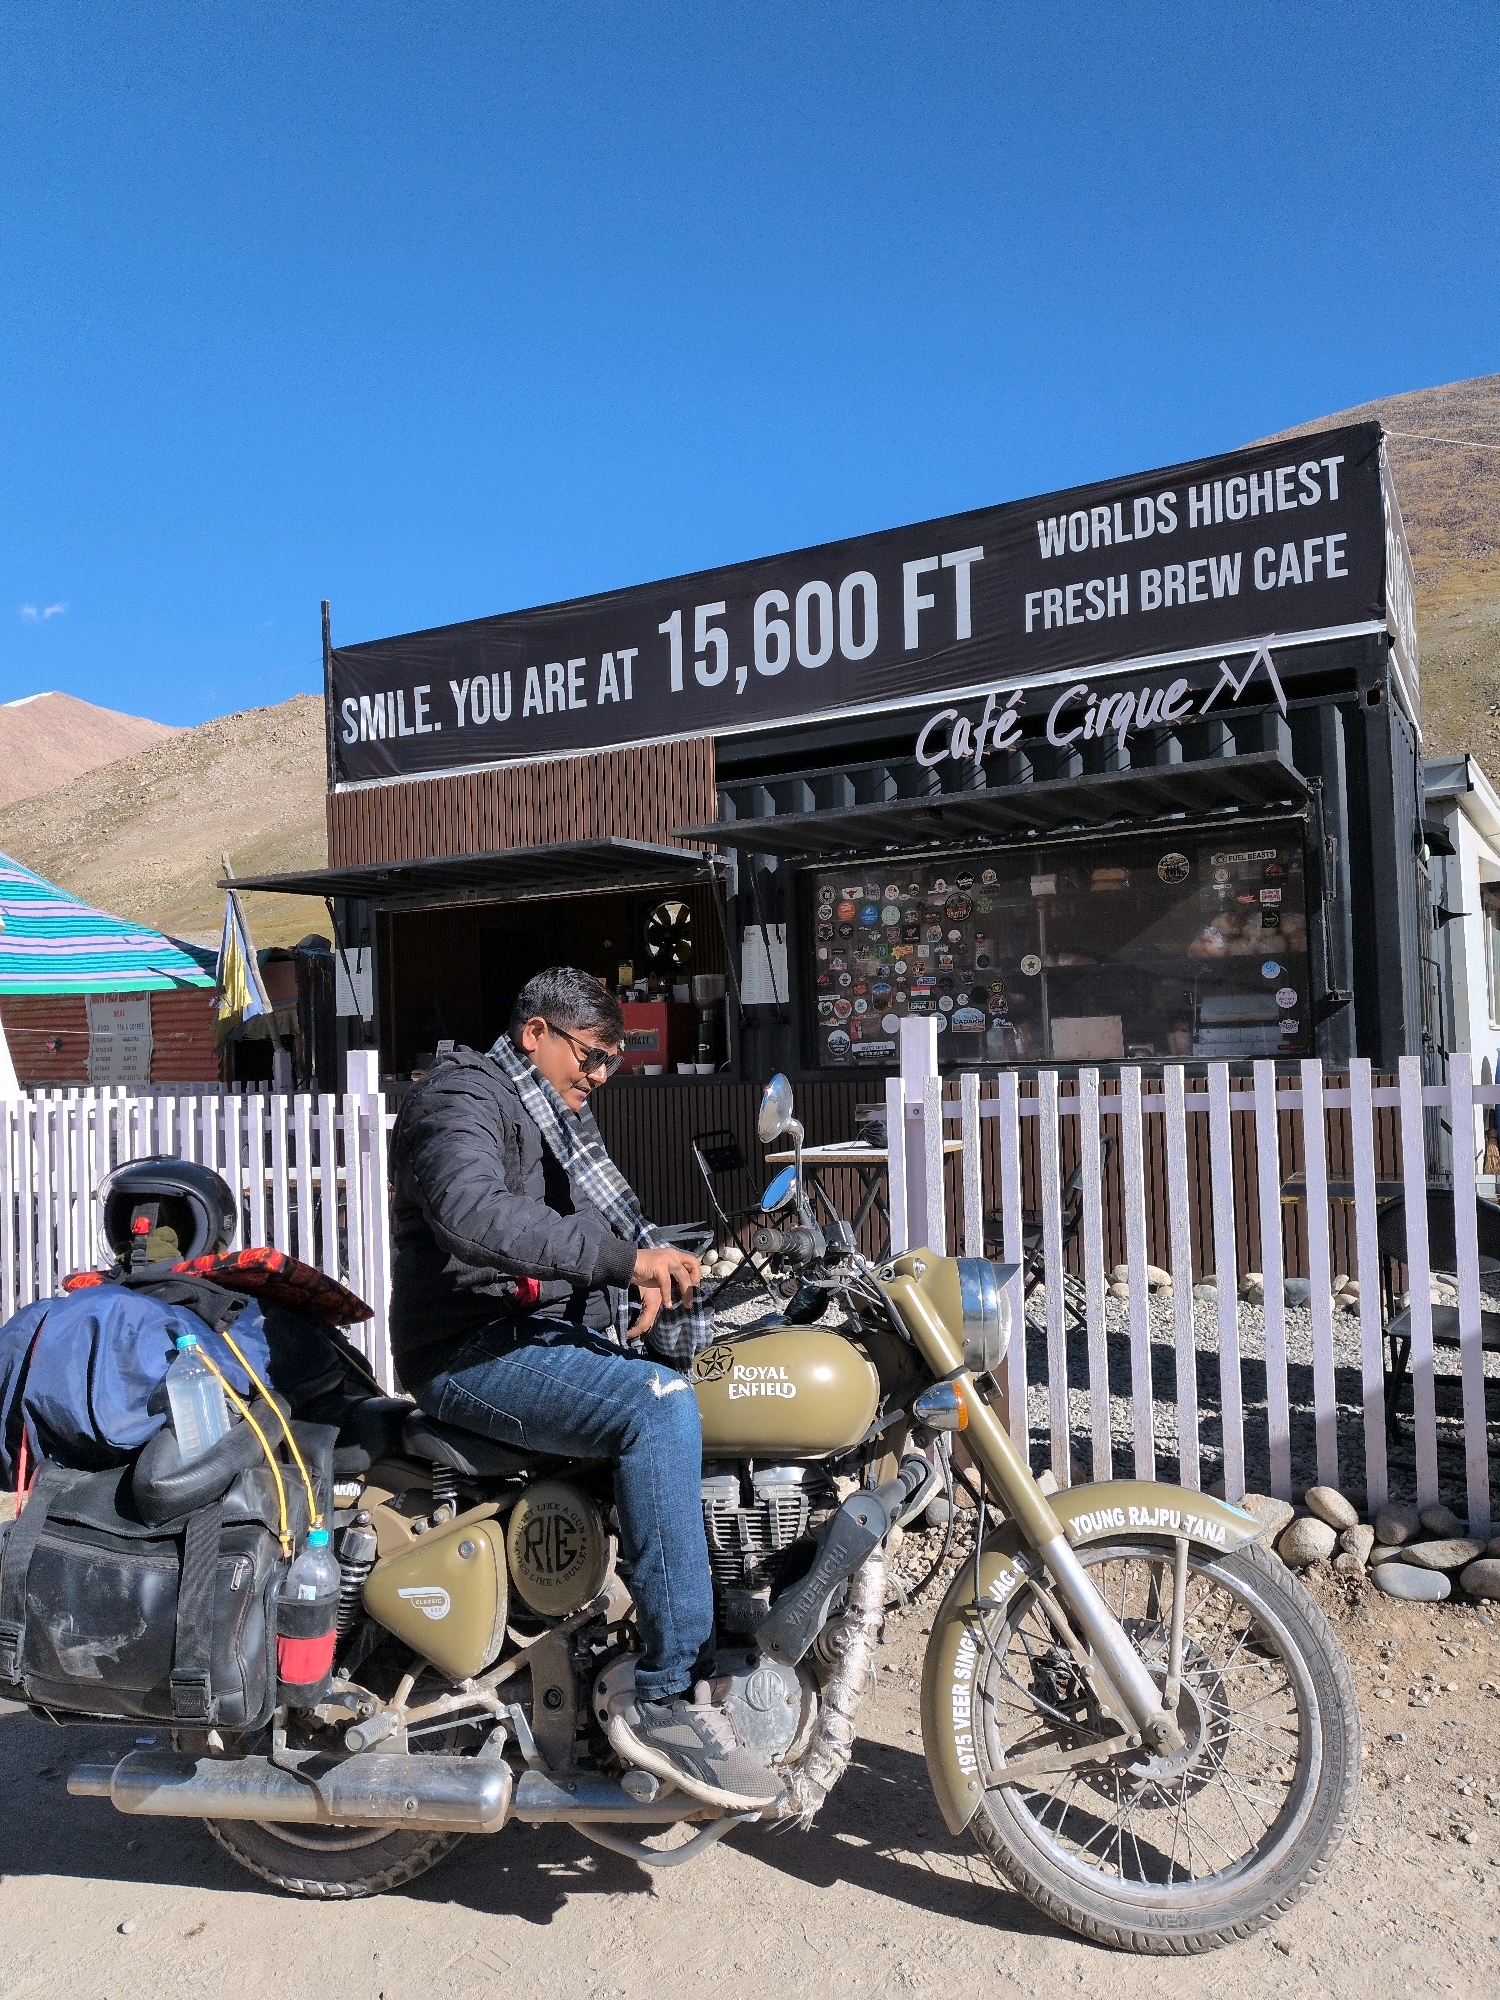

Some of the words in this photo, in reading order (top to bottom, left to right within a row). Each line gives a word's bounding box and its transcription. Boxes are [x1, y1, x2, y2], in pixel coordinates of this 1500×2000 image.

[1036, 491, 1178, 559] WORLDS
[1189, 455, 1345, 529] HIGHEST
[1025, 574, 1129, 633] FRESH
[1140, 551, 1243, 613] BREW
[1253, 532, 1349, 591] CAFE
[341, 684, 441, 745] SMILE.
[449, 674, 513, 728] YOU
[522, 657, 588, 718] ARE
[596, 647, 639, 705] AT
[658, 570, 879, 695] 15,600
[902, 545, 984, 651] FT
[916, 690, 1023, 767] Café
[1047, 677, 1194, 750] Cirque
[1228, 854, 1247, 862] FUEL
[1247, 850, 1275, 860] BEASTS
[728, 1382, 797, 1400] ENFIELD
[733, 1364, 789, 1381] ROYAL
[515, 1509, 534, 1536] BUILT
[536, 1503, 560, 1512] LIKE
[562, 1506, 569, 1514] A
[570, 1513, 586, 1534] GUN
[1069, 1508, 1126, 1537] YOUNG
[514, 1548, 529, 1575] GOES
[529, 1574, 553, 1586] LIKE
[563, 1545, 587, 1581] BULLET
[952, 1683, 972, 1731] VEER
[955, 1734, 978, 1776] 1975
